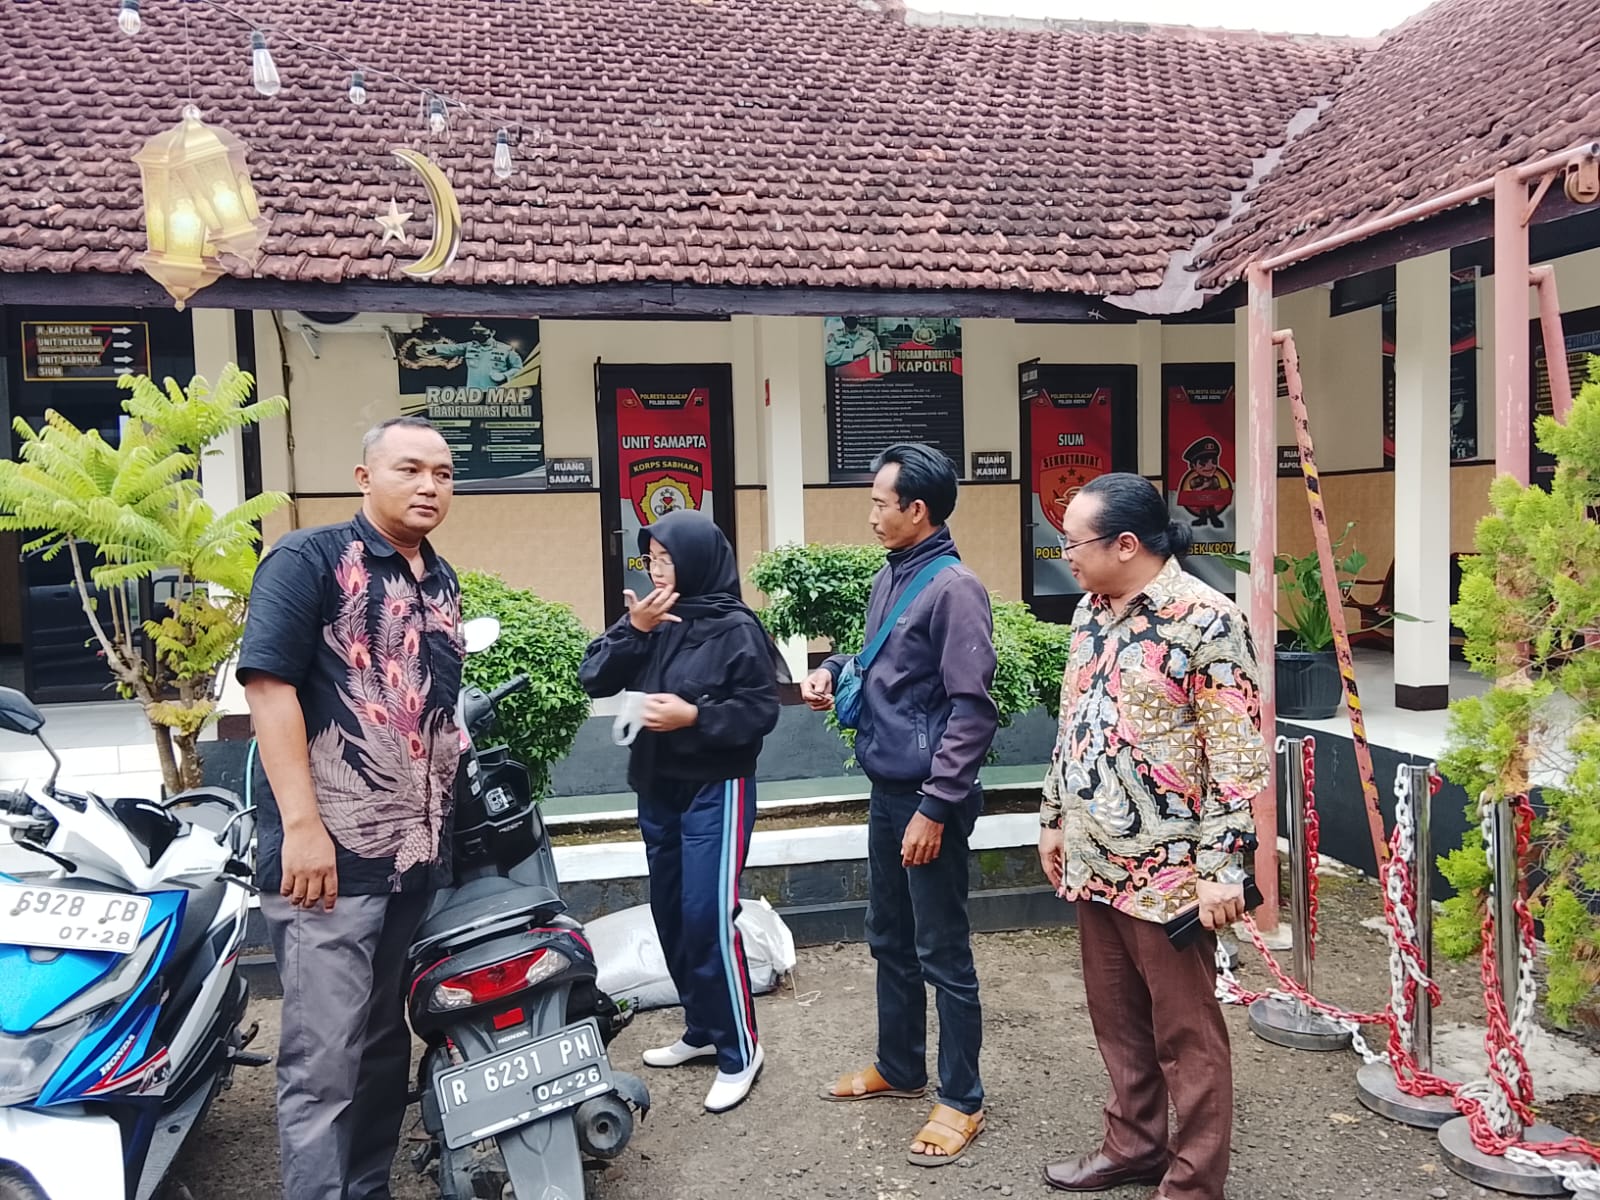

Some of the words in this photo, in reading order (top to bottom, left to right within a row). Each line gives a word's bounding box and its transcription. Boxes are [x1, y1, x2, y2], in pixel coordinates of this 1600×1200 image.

[39, 338, 57, 346] UNIT
[58, 338, 101, 346] INTELKAM
[39, 356, 57, 364] UNIT
[60, 356, 99, 364] SABHARA
[894, 350, 923, 359] PROGRAM
[924, 350, 955, 359] PRIORITAS
[866, 349, 892, 373] 16
[898, 361, 951, 372] KAPOLRI
[39, 367, 61, 376] SIUM
[426, 387, 482, 404] ROAD
[487, 387, 533, 404] MAP
[429, 405, 500, 417] TRANFORMASI
[502, 405, 532, 417] POLRI
[622, 435, 650, 449] UNIT
[653, 435, 707, 449] SAMAPTA
[1058, 434, 1084, 446] SIUM
[1283, 450, 1301, 458] RUA
[553, 462, 585, 471] RUANG
[978, 456, 1005, 465] RUANG
[1043, 453, 1100, 468] SEKRETARIAT
[633, 461, 661, 473] KORPS
[662, 461, 699, 473] SABHARA
[976, 467, 1007, 476] KASIUM
[549, 475, 590, 483] SAMAPTA
[1035, 547, 1062, 559] POLS
[1190, 544, 1206, 554] SEK
[1208, 543, 1236, 554] KROY
[16, 890, 85, 917] 6928
[106, 899, 139, 922] CB
[498, 1030, 529, 1044] HONDA
[98, 1034, 136, 1077] HONDA
[451, 1079, 468, 1106] R
[484, 1051, 542, 1092] 6231
[559, 1032, 592, 1065] PN
